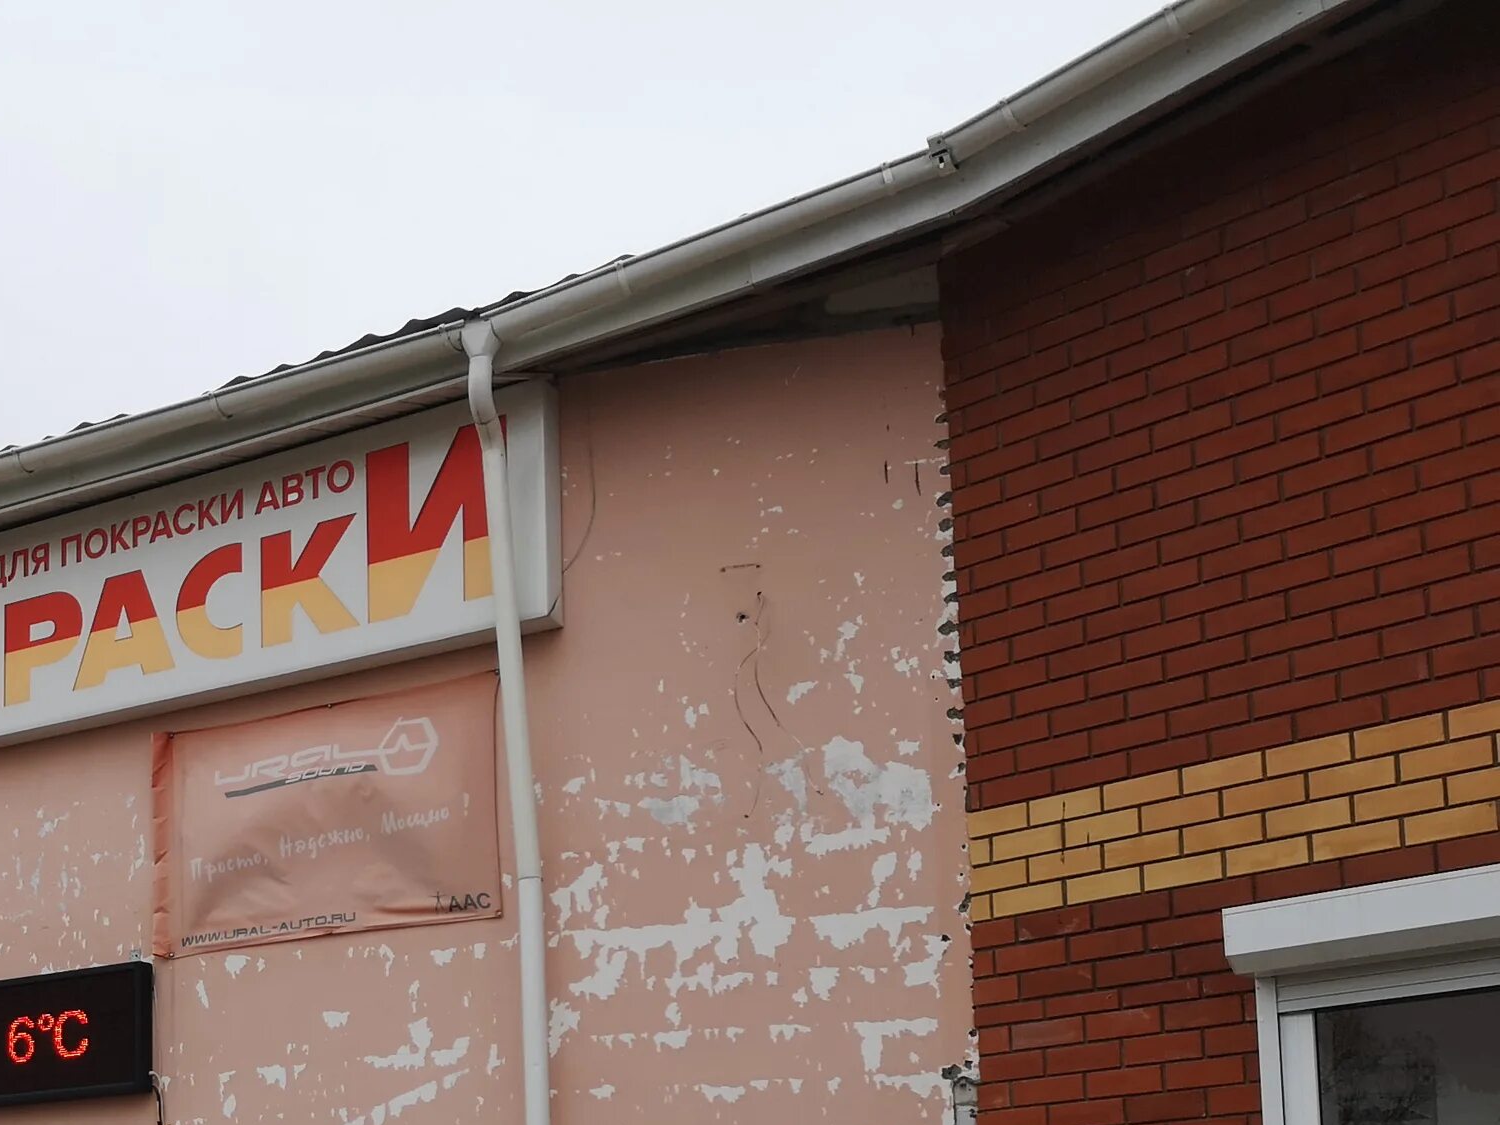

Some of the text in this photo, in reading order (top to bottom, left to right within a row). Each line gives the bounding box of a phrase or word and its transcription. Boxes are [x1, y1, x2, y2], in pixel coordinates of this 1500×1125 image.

[60, 489, 245, 564] ПОКРАСКИ
[255, 460, 356, 515] АВТО
[285, 761, 367, 784] SOUND
[181, 912, 357, 948] WWW.URAL-AUTO.RU
